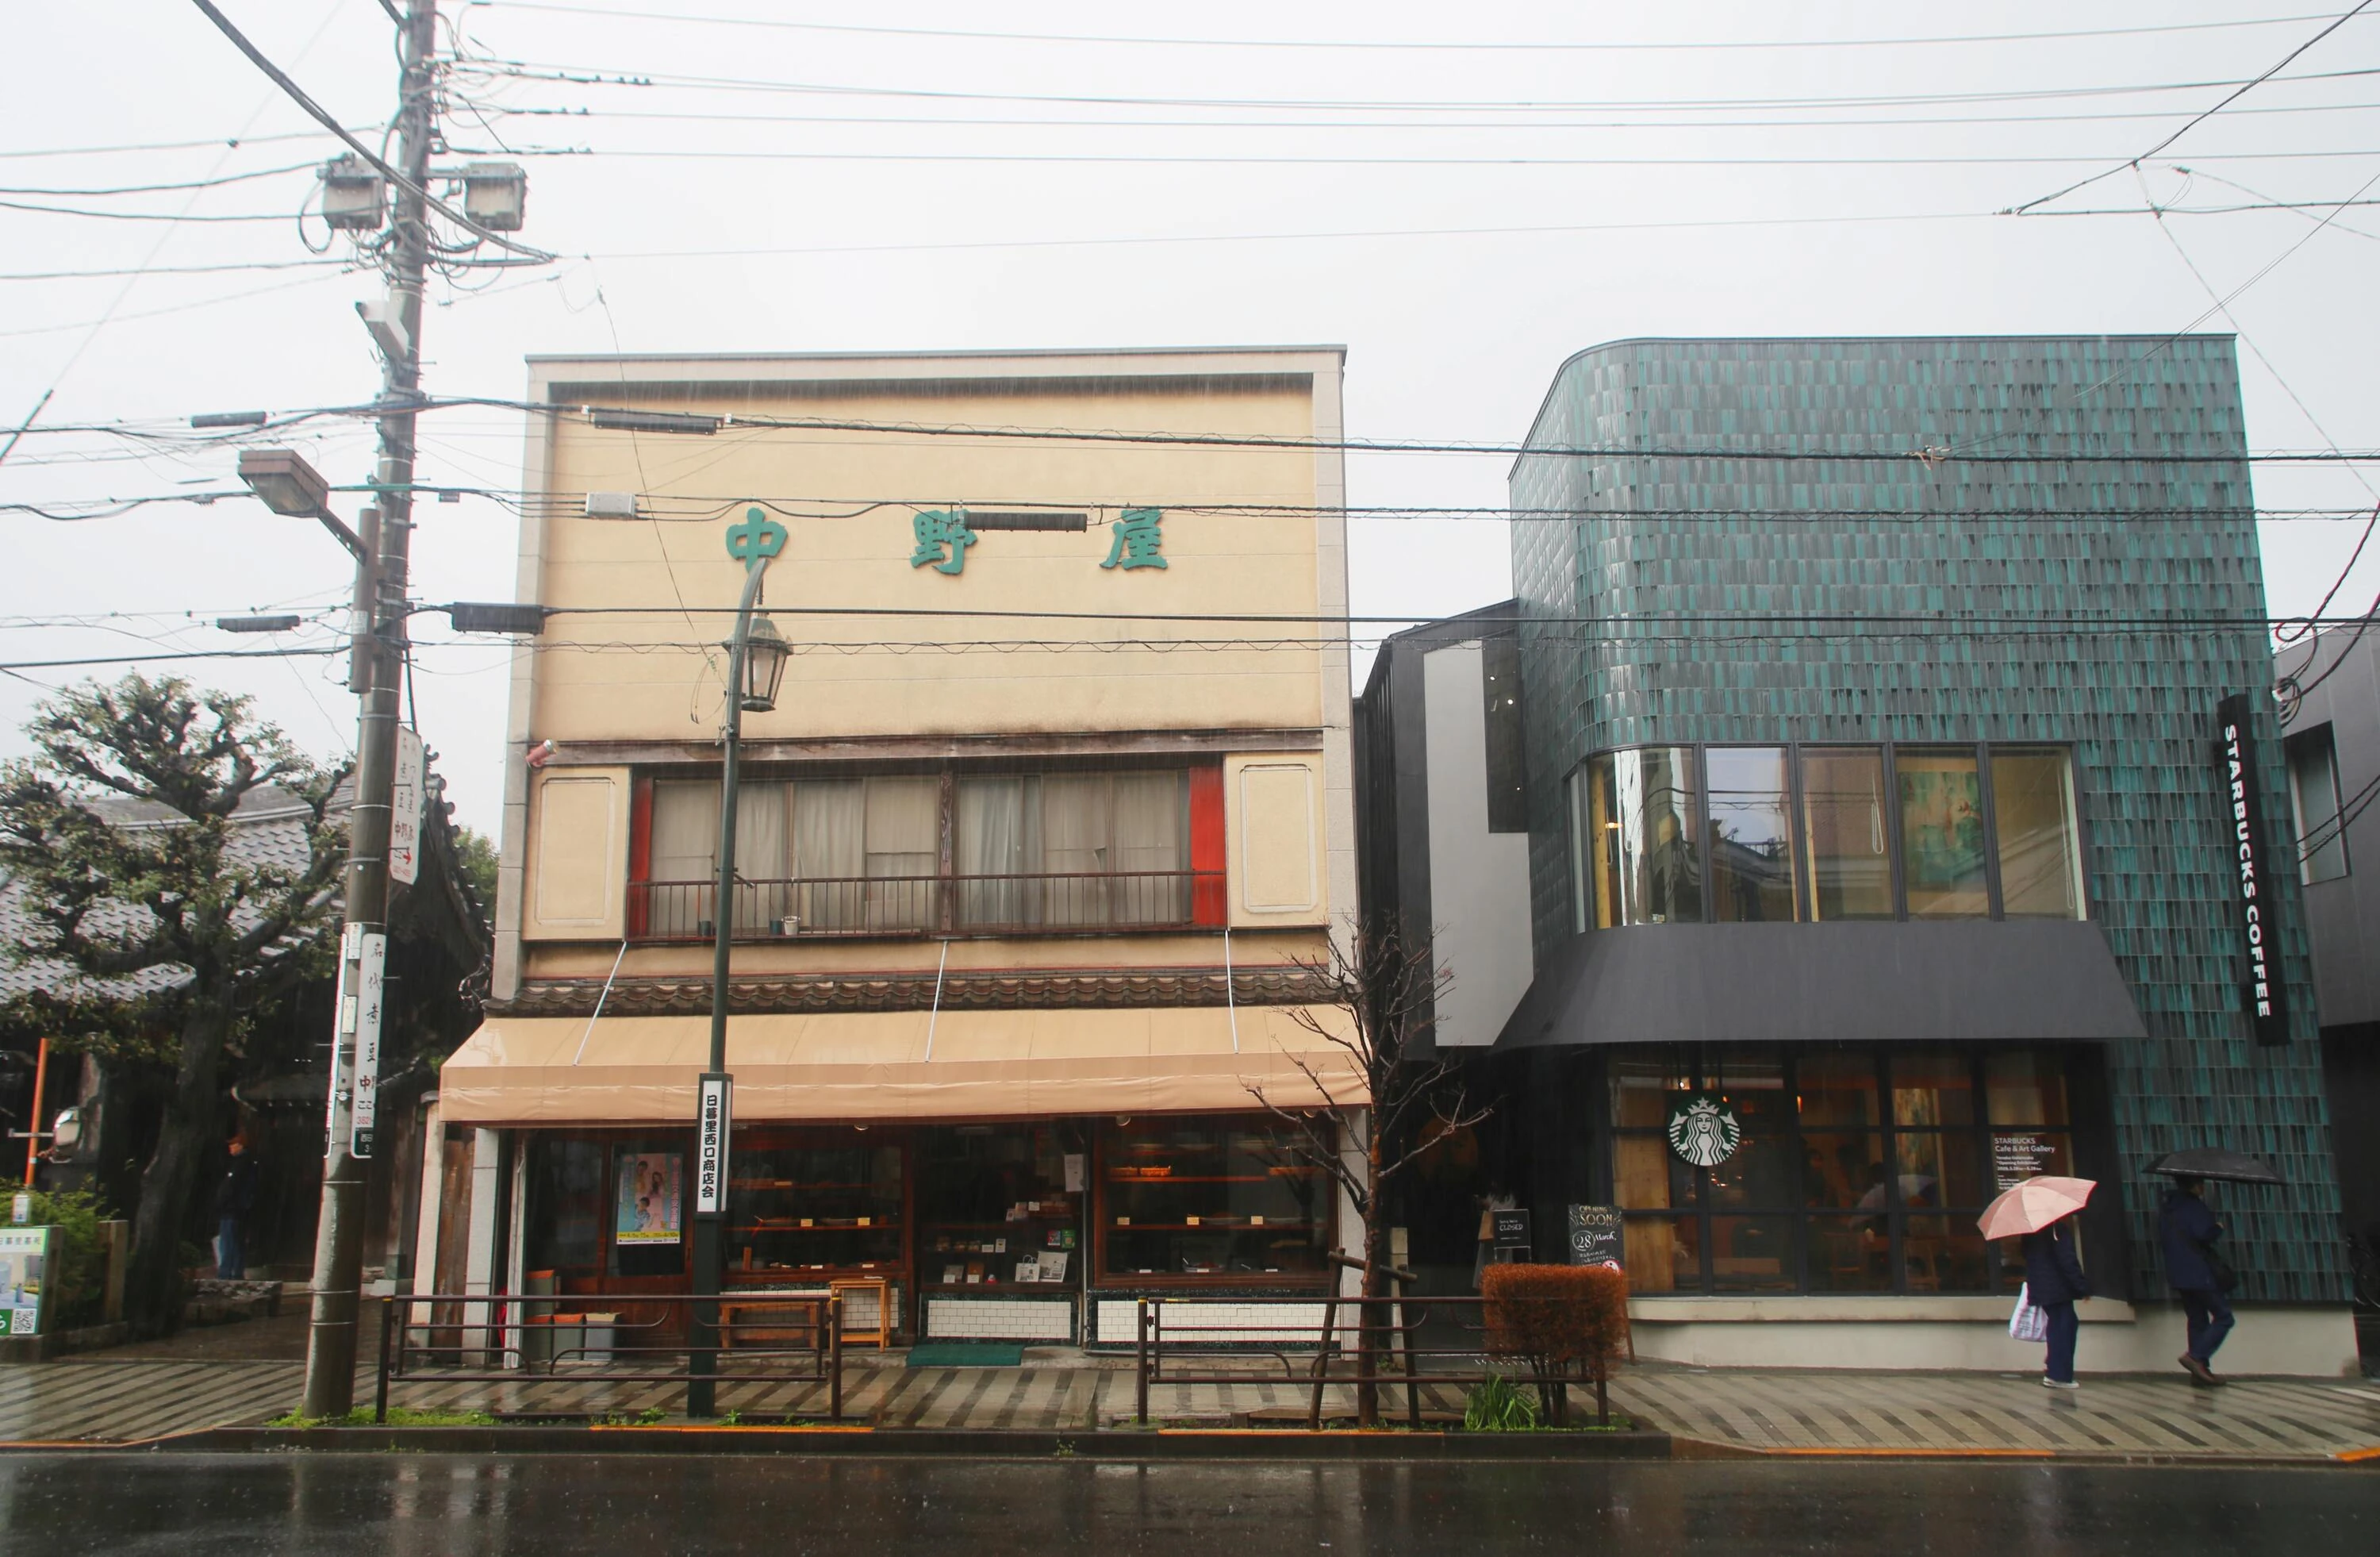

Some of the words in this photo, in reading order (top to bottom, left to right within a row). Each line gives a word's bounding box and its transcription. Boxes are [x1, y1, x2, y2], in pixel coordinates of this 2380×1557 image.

[725, 507, 1168, 575] 中野屋
[2225, 724, 2255, 898] STARBUCKS
[2246, 905, 2271, 1017] COFFEE
[702, 1094, 717, 1198] 日暮里西口商店会
[2031, 1145, 2056, 1154] Gallery
[1580, 1213, 1613, 1227] SOON
[1577, 1234, 1591, 1248] 28
